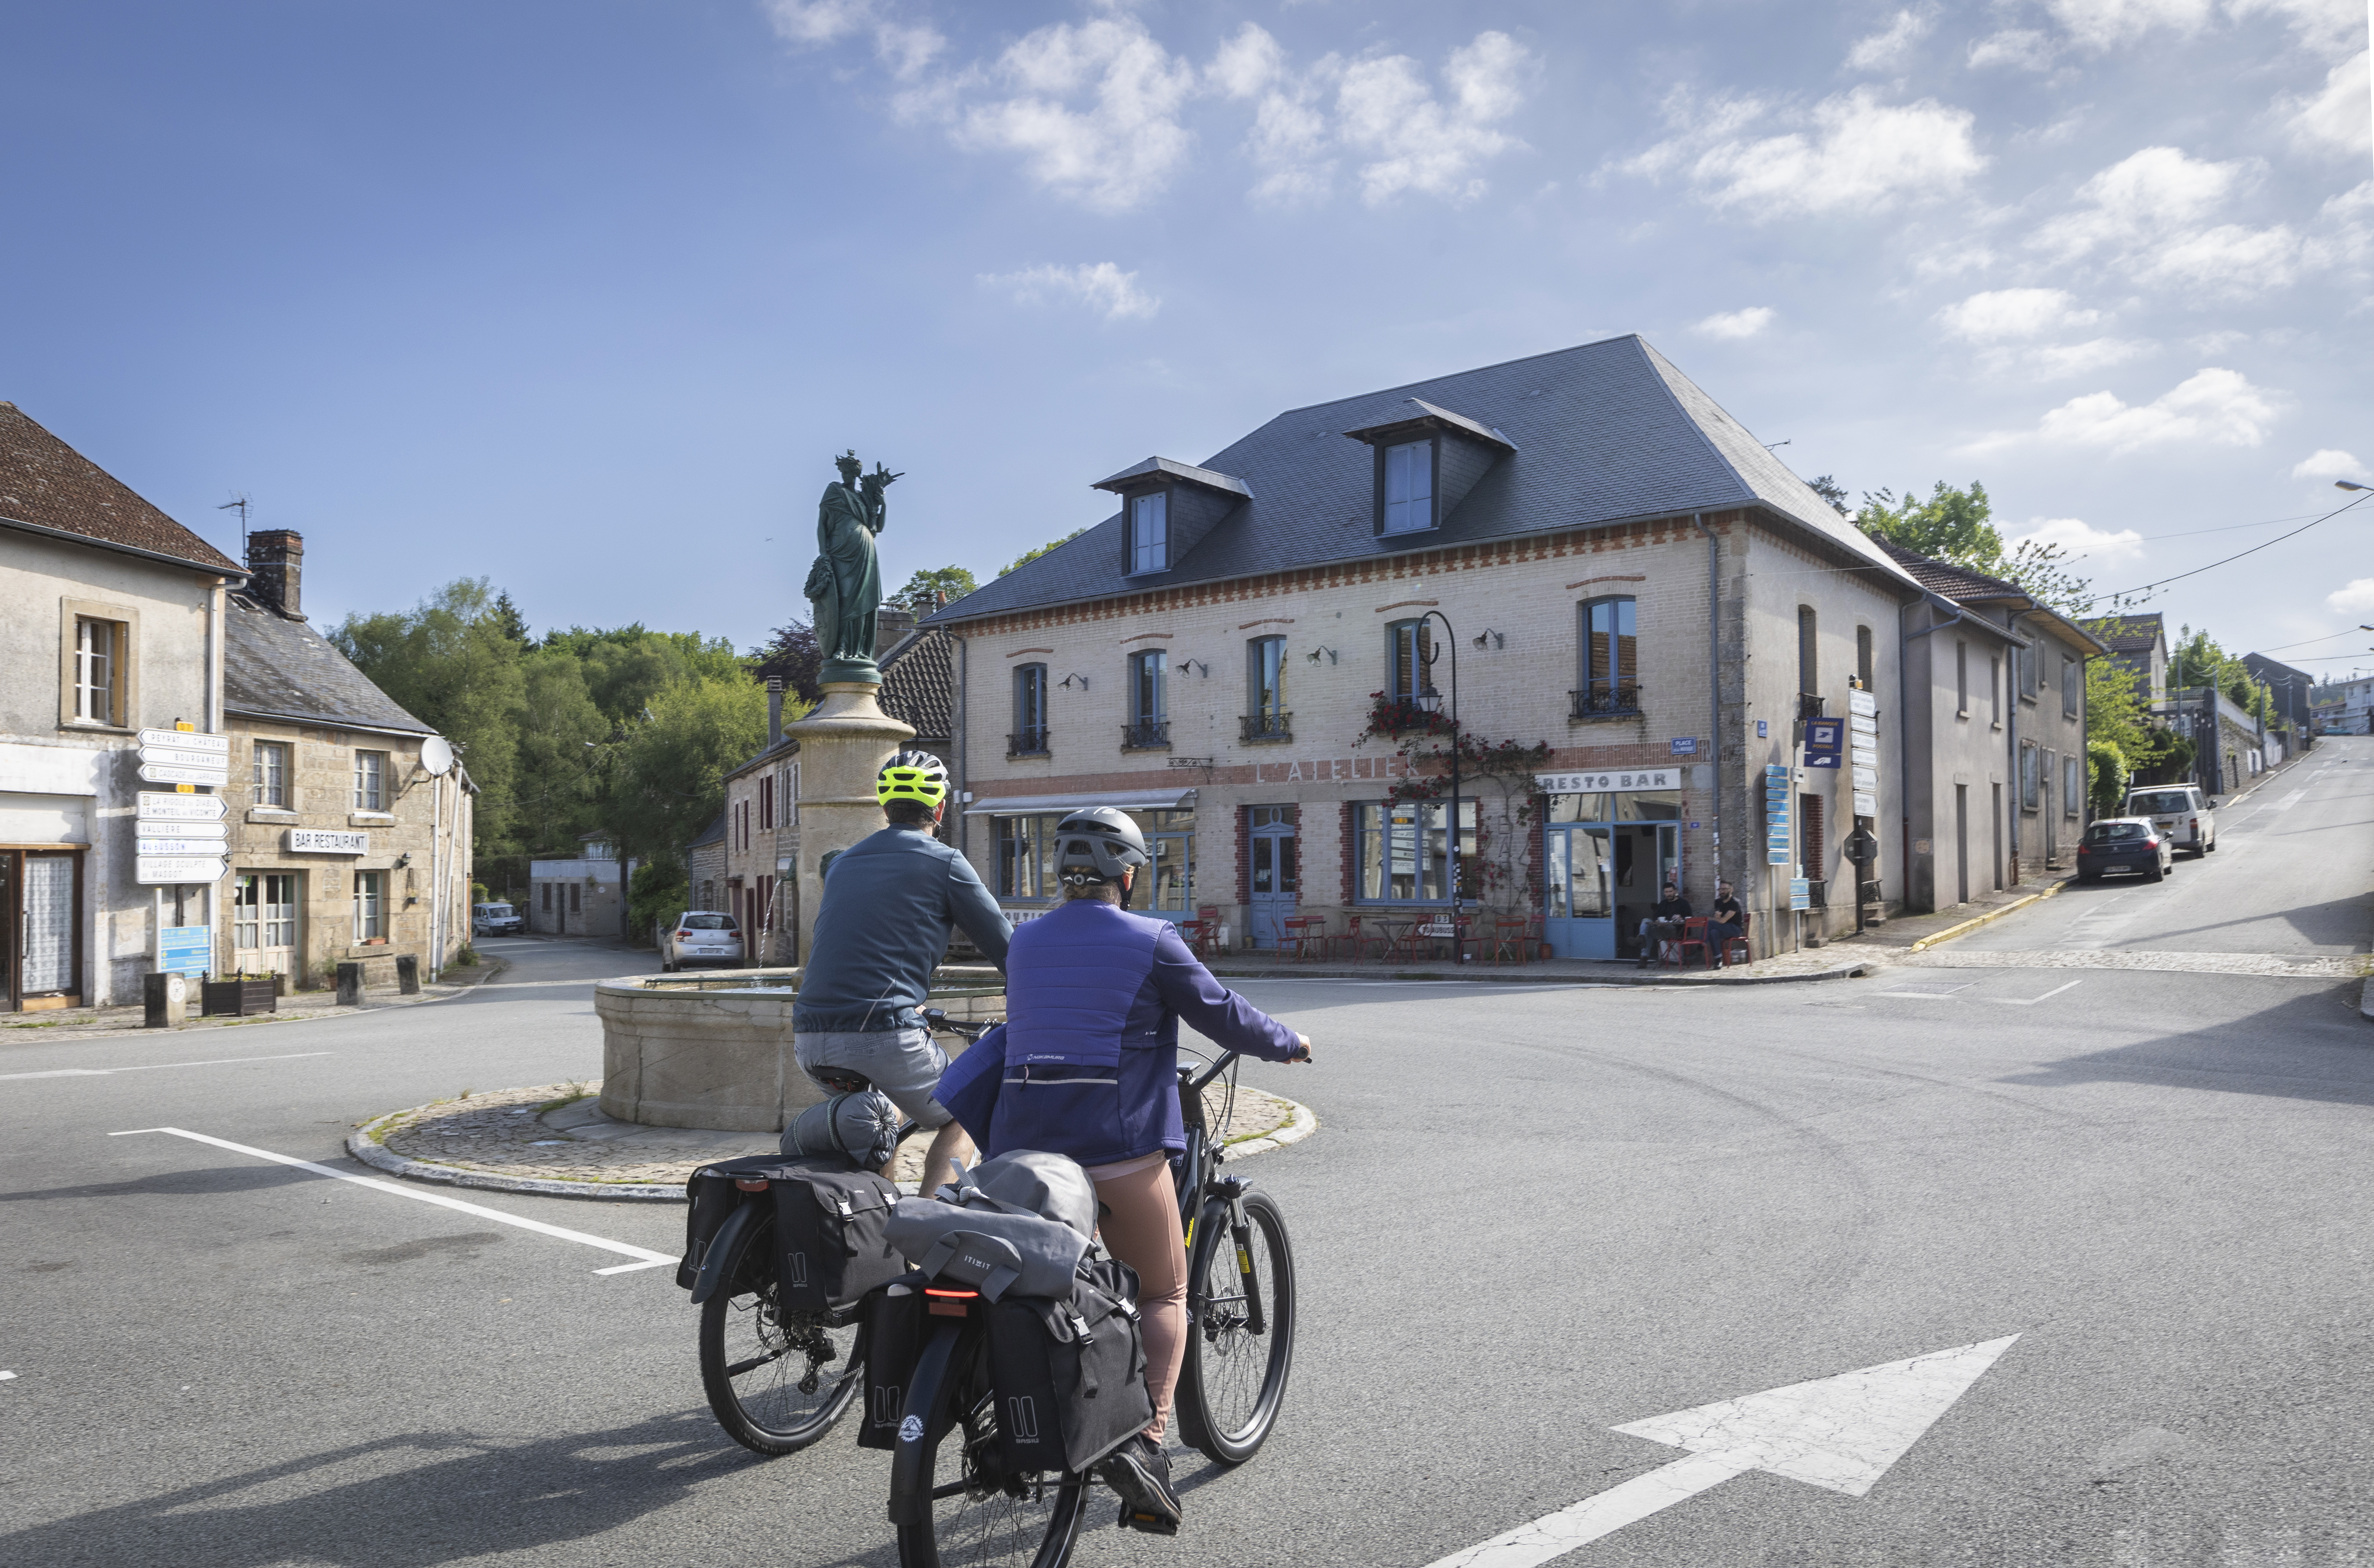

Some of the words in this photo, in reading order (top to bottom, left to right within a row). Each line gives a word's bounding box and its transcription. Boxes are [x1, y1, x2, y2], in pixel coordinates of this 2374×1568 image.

[151, 734, 180, 743] PEYRAT
[175, 753, 225, 764] BOURGANEUF
[159, 769, 186, 779] CASCADE
[1543, 776, 1610, 790] RESTO
[1620, 773, 1667, 787] BAR
[163, 797, 186, 806] RIGOLE
[296, 834, 311, 848] BAR
[315, 834, 365, 849] RESTAURANT
[1005, 912, 1044, 922] OUTI
[964, 1255, 991, 1270] ITIWIT
